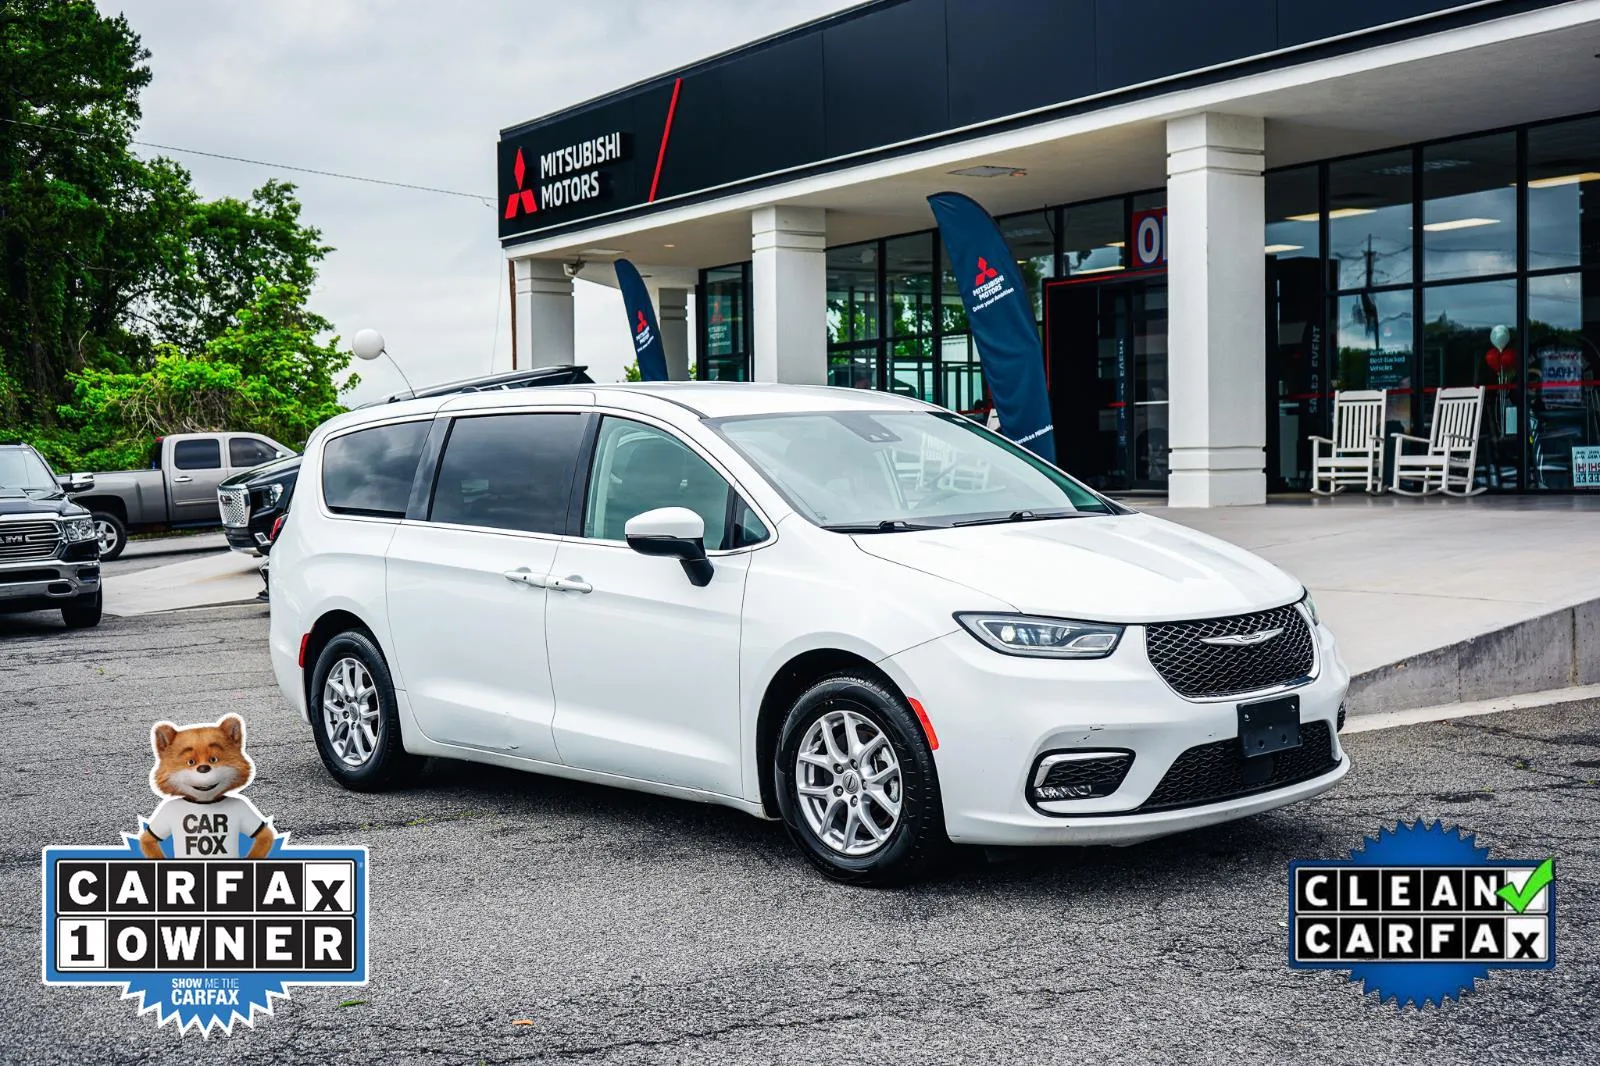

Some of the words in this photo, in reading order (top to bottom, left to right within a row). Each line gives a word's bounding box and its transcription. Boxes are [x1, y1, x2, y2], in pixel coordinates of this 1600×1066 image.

[540, 132, 621, 179] MITSUBISHI
[541, 171, 599, 210] MOTORS
[1138, 213, 1168, 264] O
[972, 303, 984, 312] Drive
[985, 297, 994, 307] your
[995, 287, 1014, 301] Ambition
[973, 275, 1005, 296] MITSUBISHI
[979, 284, 1002, 300] MOTORS
